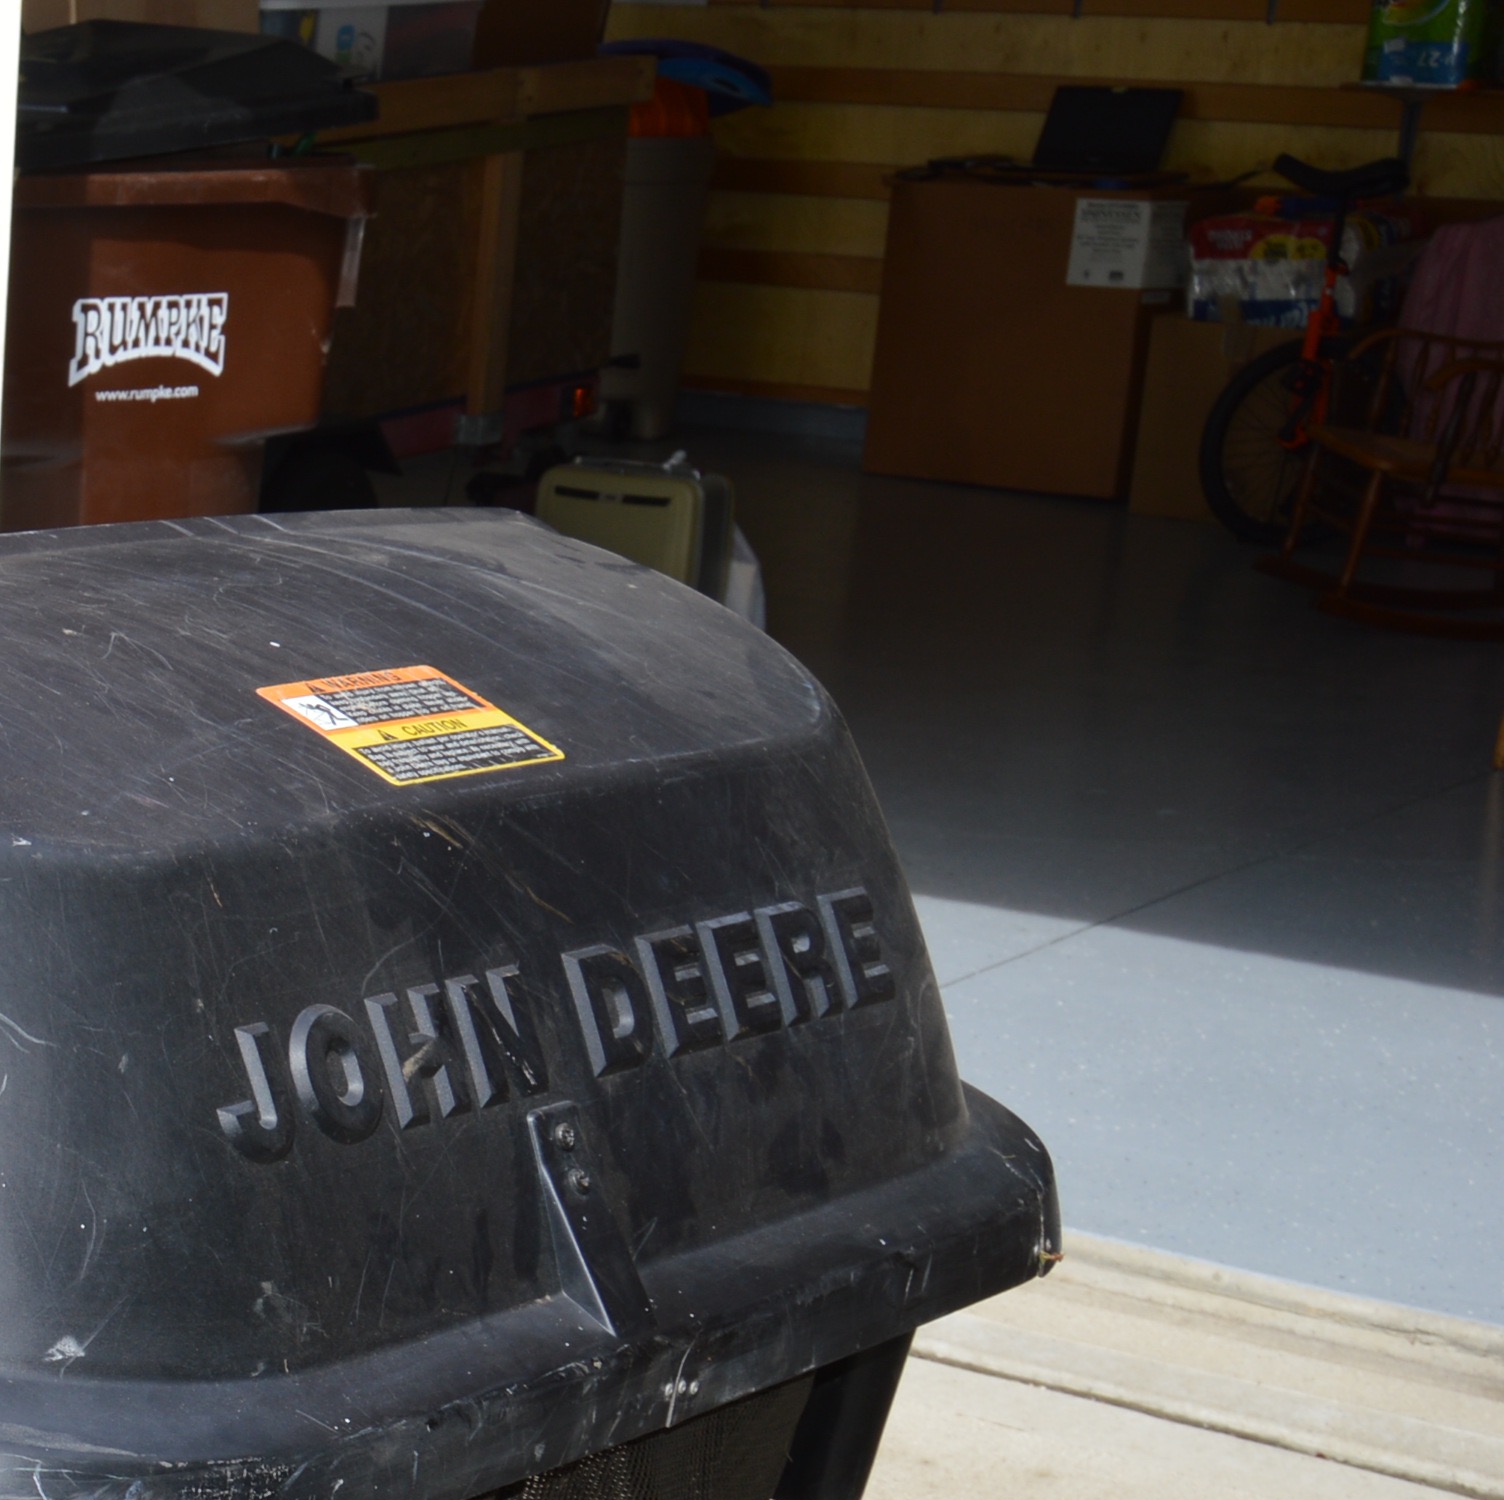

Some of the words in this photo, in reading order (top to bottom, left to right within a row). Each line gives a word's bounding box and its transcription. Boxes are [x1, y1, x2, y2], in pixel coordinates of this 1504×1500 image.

[68, 292, 229, 387] RUMPKE
[95, 384, 199, 403] www.rumpke.com
[324, 671, 402, 693] WARNING
[400, 718, 468, 737] CAUTION
[216, 963, 551, 1165] JOHN
[561, 886, 896, 1079] DEERE
